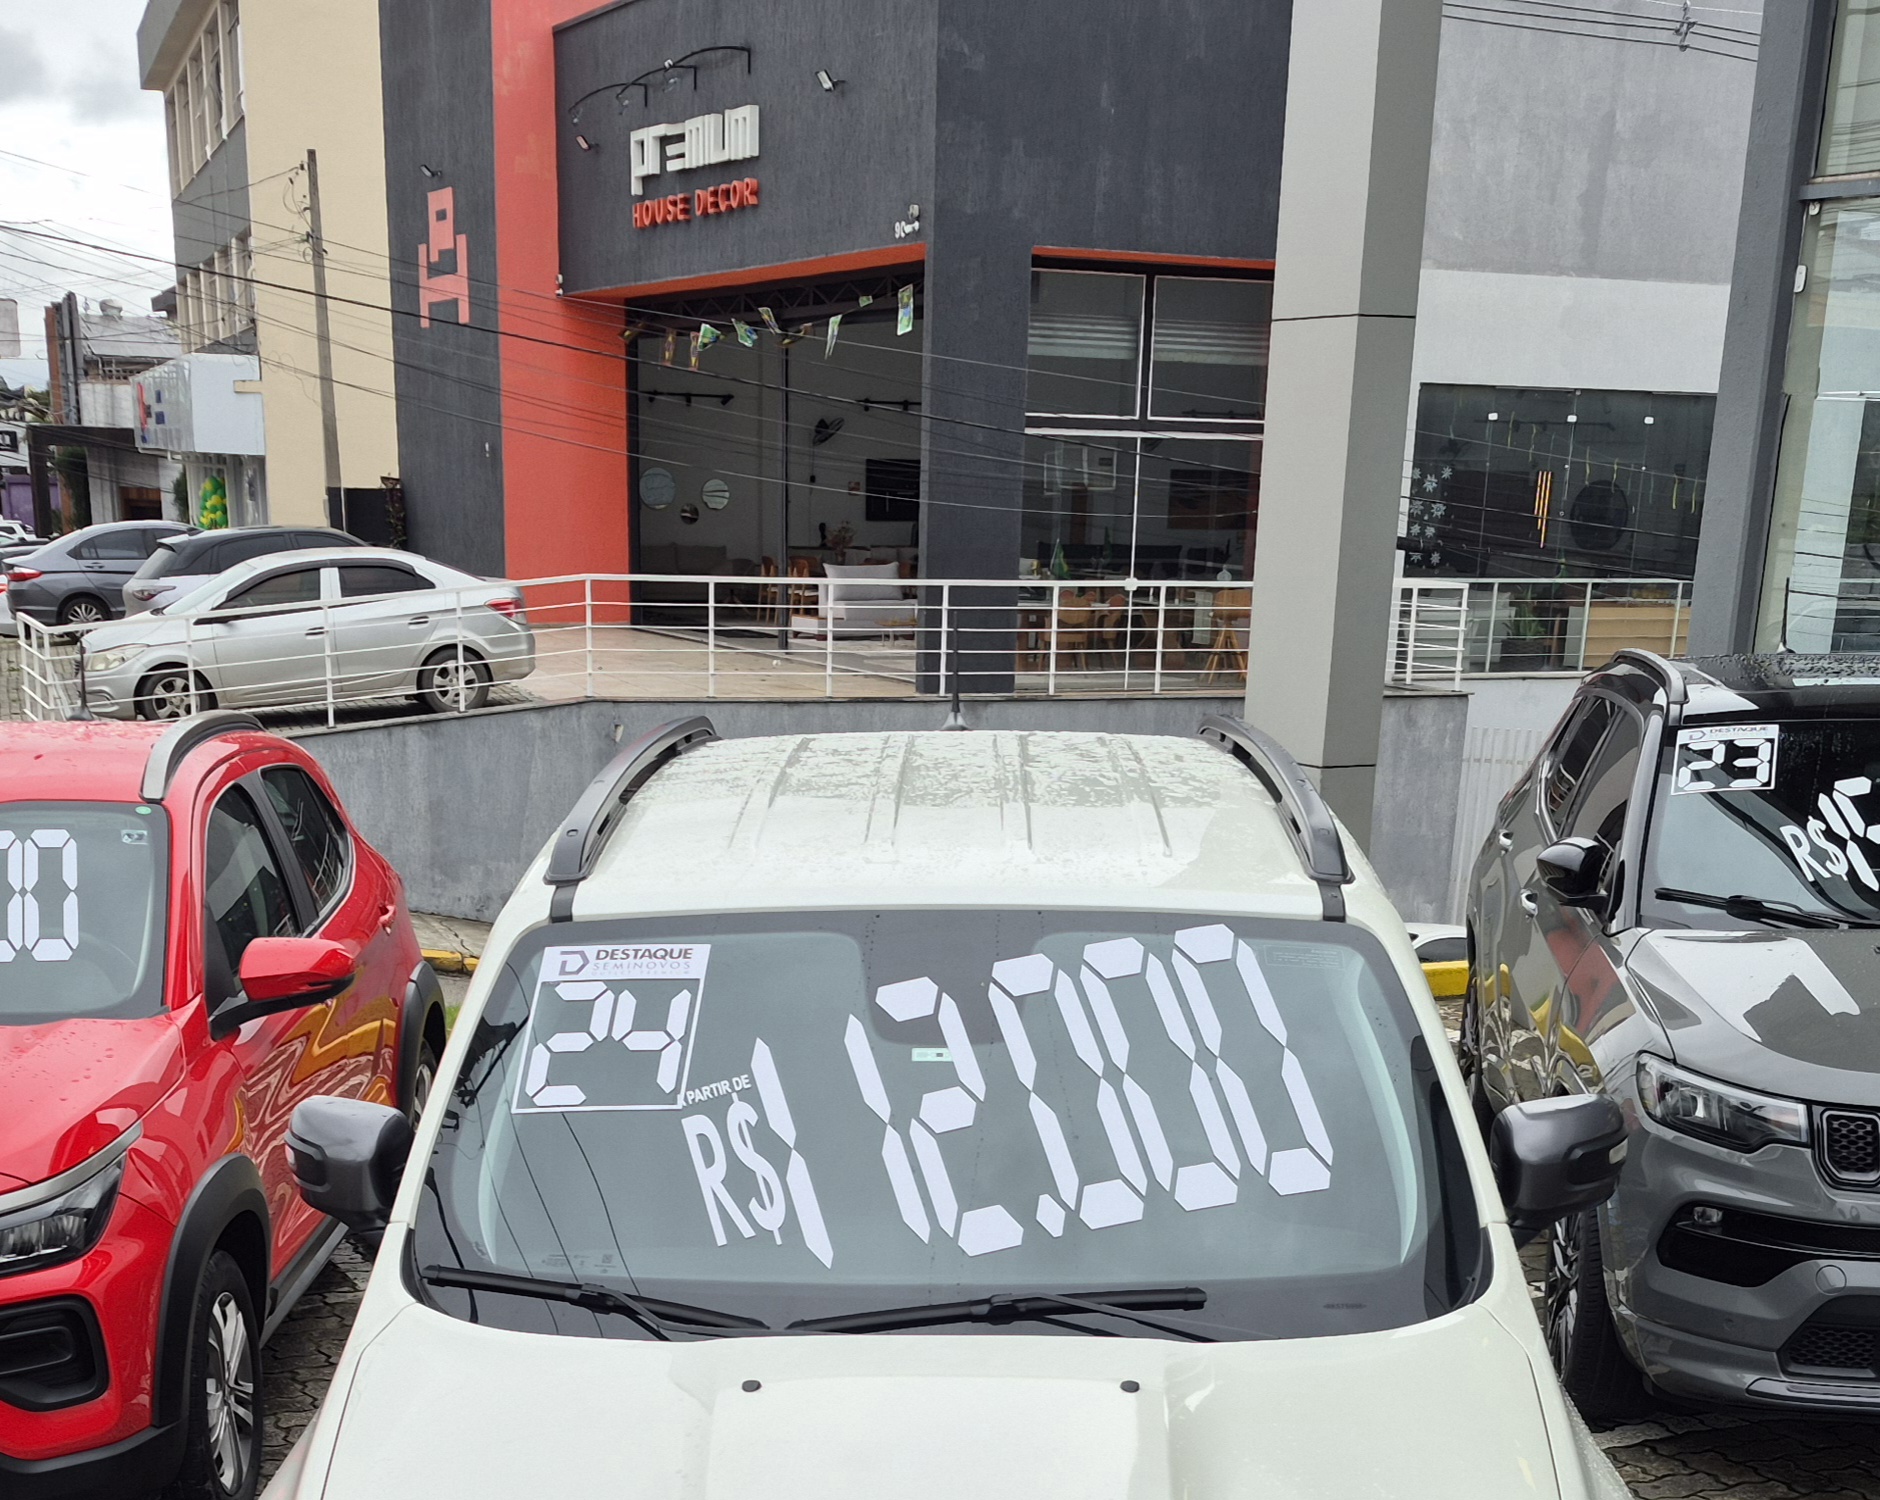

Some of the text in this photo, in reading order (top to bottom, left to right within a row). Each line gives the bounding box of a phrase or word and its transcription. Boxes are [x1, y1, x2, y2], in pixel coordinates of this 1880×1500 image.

[632, 178, 759, 228] HOUSE DECOR
[1678, 738, 1772, 791] 23
[592, 960, 691, 971] SEMINOVOS
[595, 948, 693, 961] DESTAQUE
[525, 982, 692, 1107] 24
[686, 1080, 732, 1105] PARTIR
[732, 1074, 752, 1092] DE
